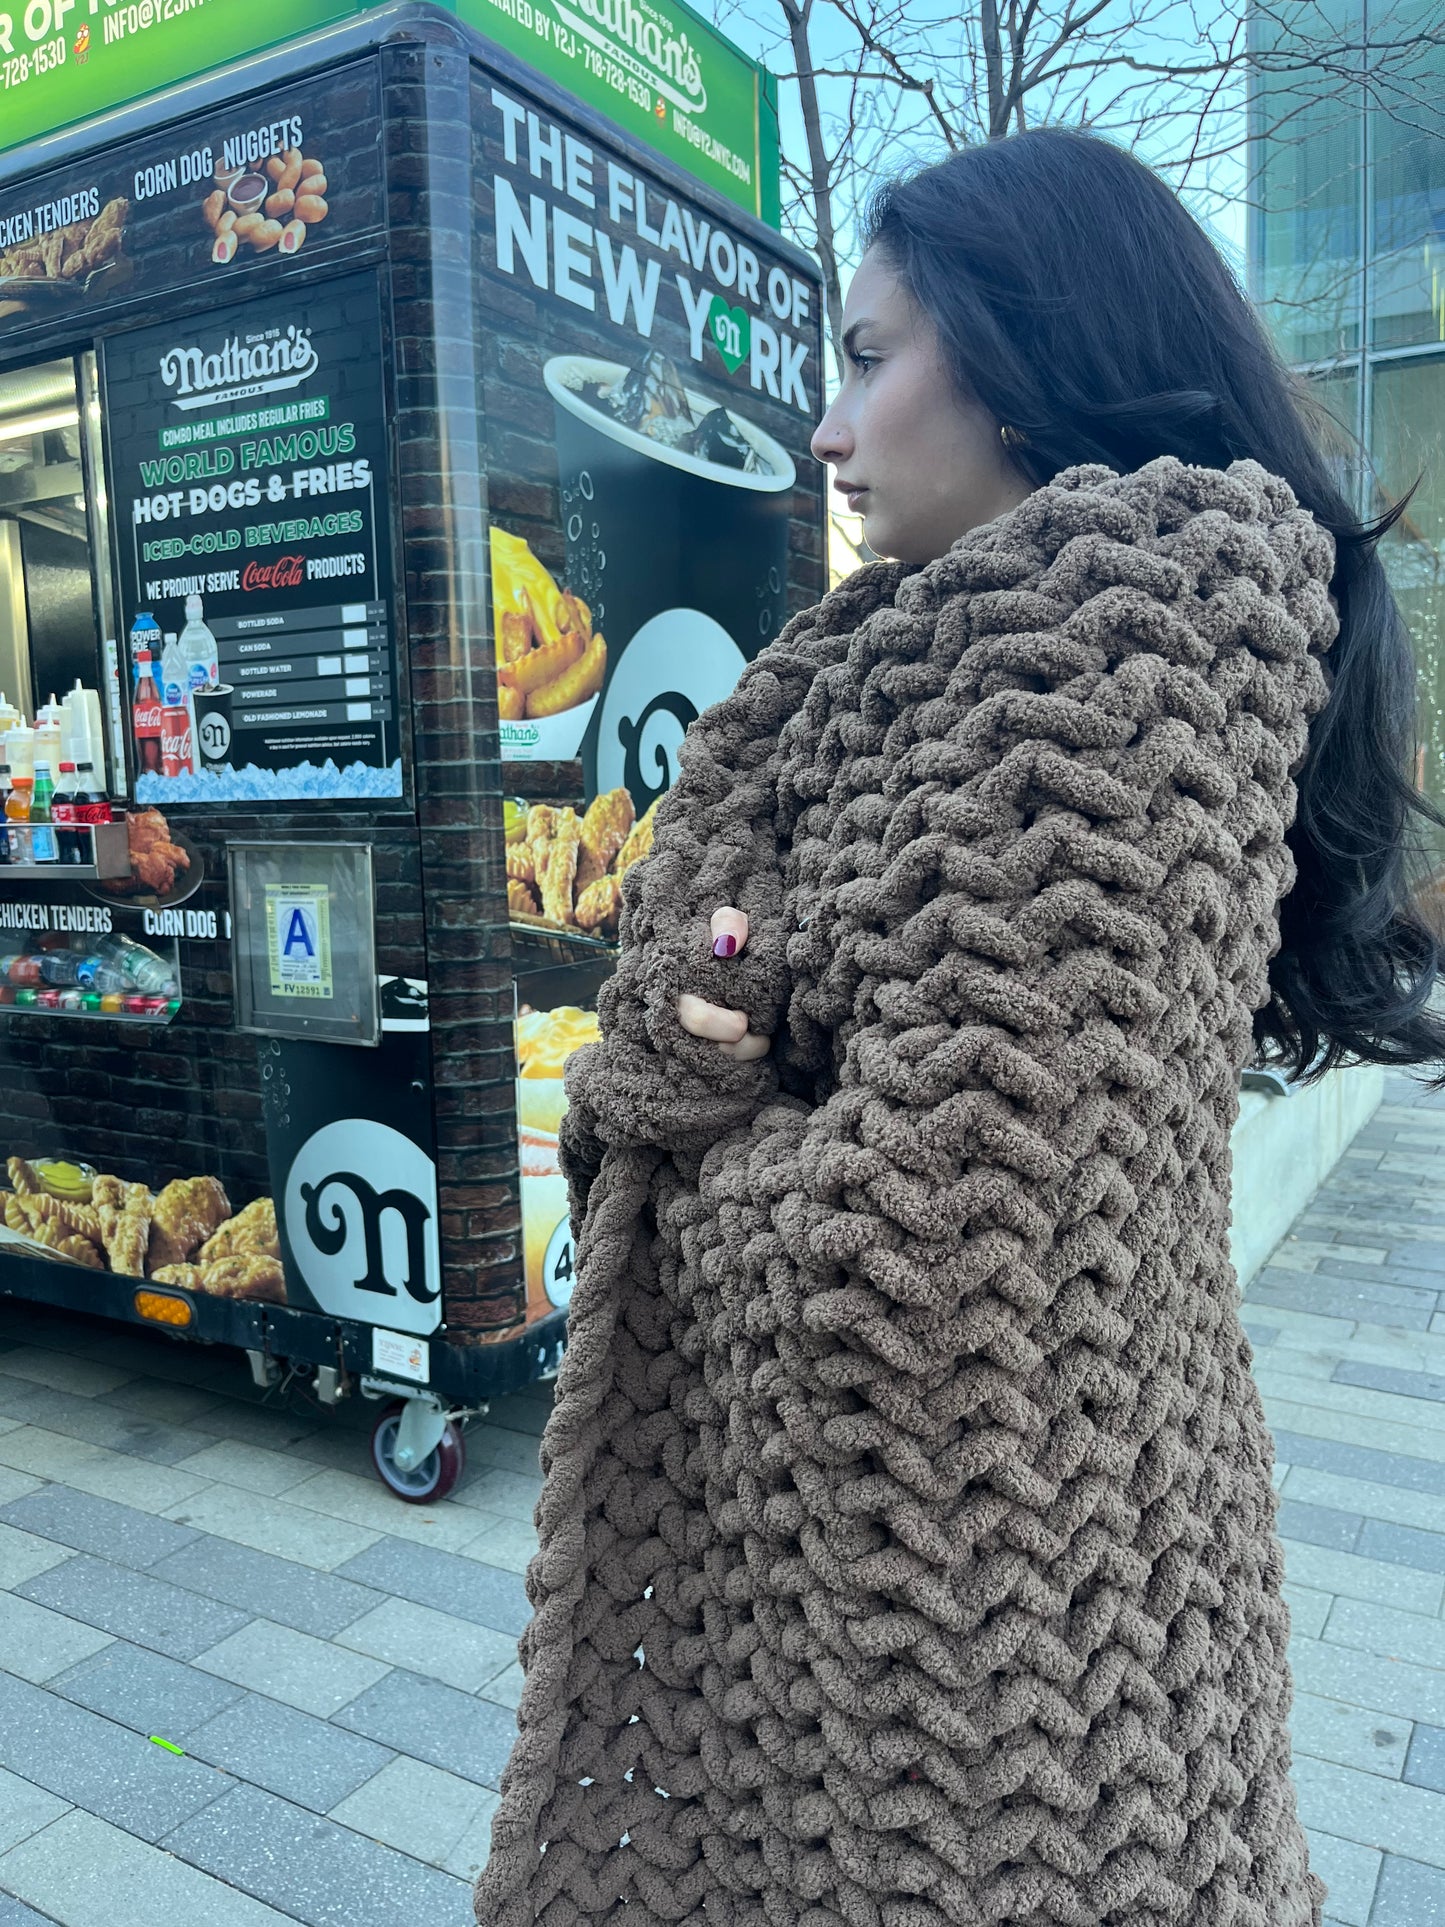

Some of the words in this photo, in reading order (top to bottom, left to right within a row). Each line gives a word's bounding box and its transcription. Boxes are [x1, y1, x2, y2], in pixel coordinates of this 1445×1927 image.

[534, 9, 550, 41] BY
[552, 21, 576, 59] Y2J
[583, 43, 651, 112] 718-728-1530
[673, 109, 751, 186] INFO@Y2JNYC.COM
[134, 159, 177, 201] CORN
[180, 147, 213, 186] DOG
[223, 115, 303, 170] NUGGETS
[35, 187, 100, 234] TENDERS
[492, 88, 595, 209] THE
[607, 161, 760, 305] FLAVOR
[767, 266, 810, 328] OF
[493, 174, 662, 338] NEW
[160, 325, 312, 395] Nathan's
[215, 384, 264, 401] FAMOUS
[163, 426, 191, 447] COMBO
[192, 422, 216, 441] MEAL
[217, 415, 258, 437] INCLUDES
[258, 405, 299, 429] REGULAR
[299, 399, 325, 420] FRIES
[139, 446, 235, 487] WORLD
[240, 423, 357, 470] FAMOUS
[133, 491, 184, 524] HOT
[189, 478, 261, 515] DOGS
[267, 474, 286, 502] &
[292, 459, 371, 498] FRIES
[143, 528, 241, 563] ICED-COLD
[244, 510, 363, 547] BEVERAGES
[146, 581, 161, 600] WE
[207, 570, 240, 592] SERVE
[242, 555, 305, 592] Coca-Cola
[306, 553, 366, 581] PRODUCTS
[131, 629, 160, 642] POWER
[238, 619, 265, 629] BOTTLED
[266, 617, 284, 626] SODA
[239, 644, 253, 653] CAN
[253, 642, 271, 652] SODA
[240, 666, 268, 676] BOTTLED
[268, 664, 292, 674] WATER
[50, 905, 113, 934] TENDERS
[143, 908, 185, 937] CORN
[186, 910, 217, 939] DOG
[283, 908, 315, 957] A
